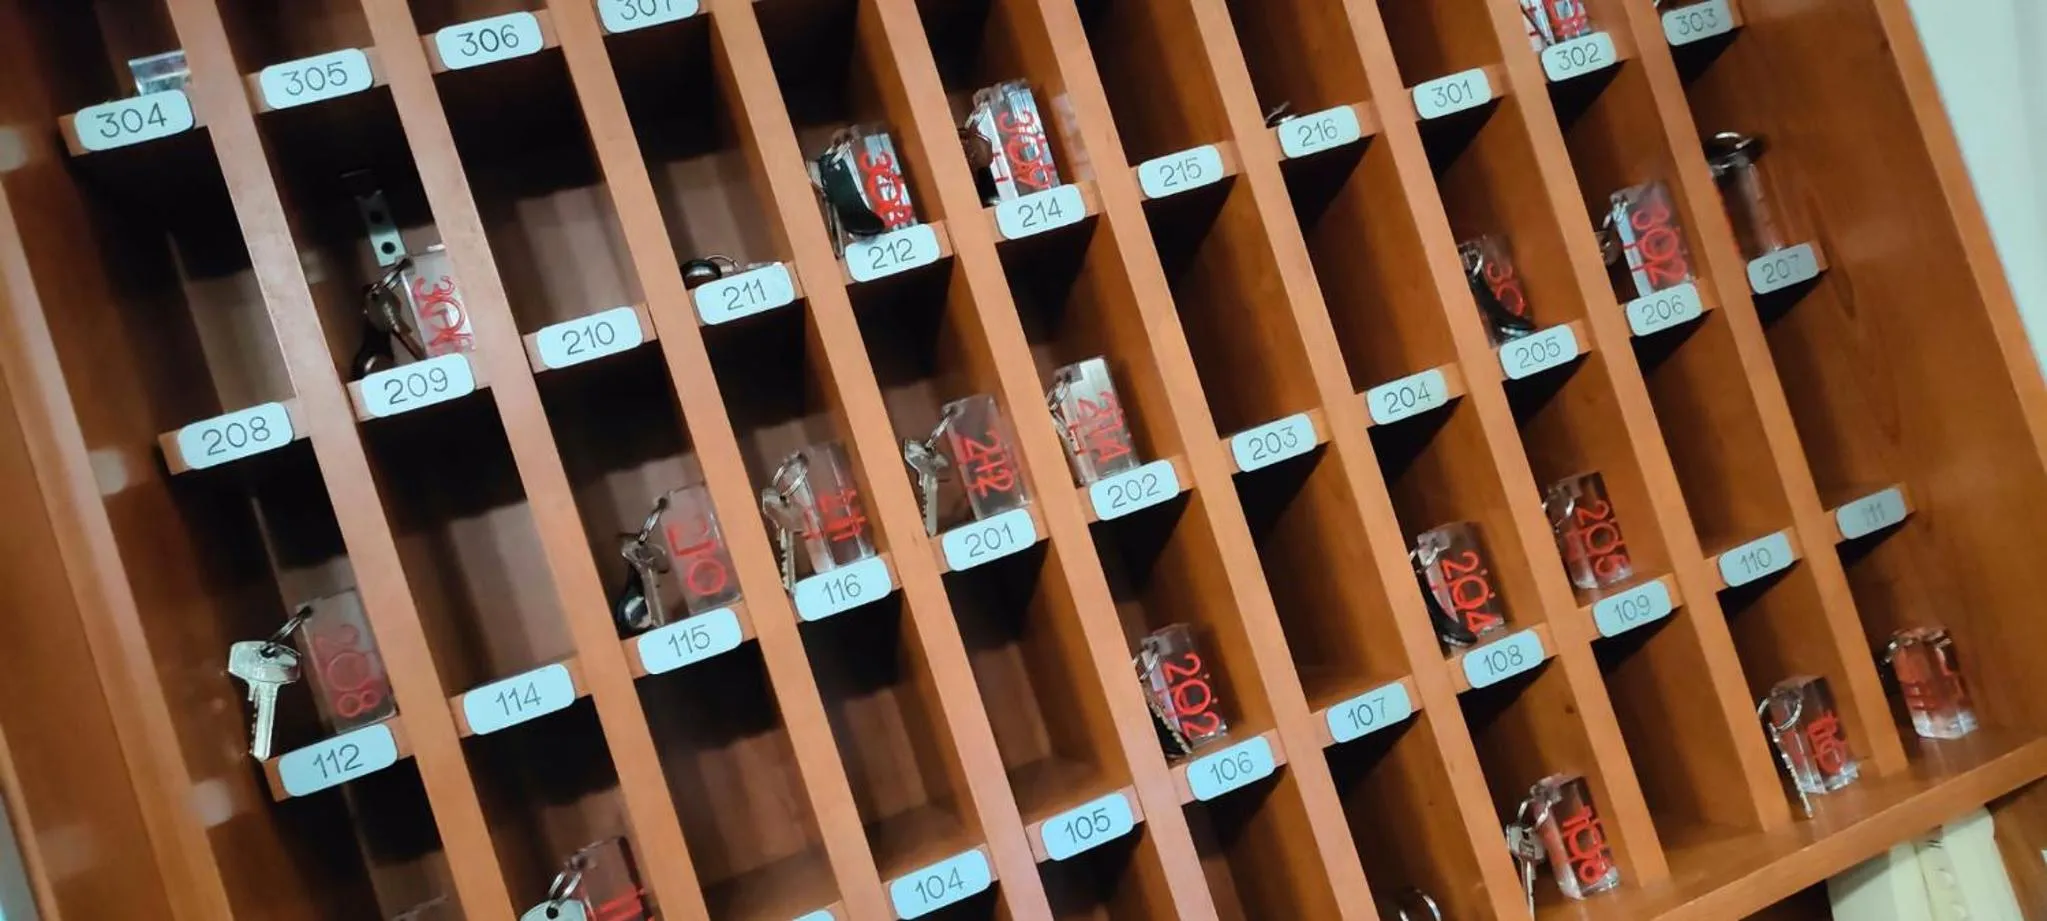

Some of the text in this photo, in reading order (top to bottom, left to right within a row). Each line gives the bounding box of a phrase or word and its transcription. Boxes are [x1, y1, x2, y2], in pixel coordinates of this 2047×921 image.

[1676, 8, 1717, 35] 303
[458, 24, 519, 56] 306
[1556, 42, 1602, 71] 302
[282, 61, 347, 96] 305
[1432, 80, 1472, 108] 301
[96, 102, 168, 139] 304
[1298, 119, 1337, 147] 216
[1160, 157, 1201, 187] 215
[1017, 196, 1063, 229] 214
[868, 238, 916, 270] 212
[1631, 203, 1687, 286] 302
[723, 278, 766, 311] 211
[1486, 262, 1525, 317] 30
[1642, 295, 1685, 326] 206
[562, 322, 614, 355] 210
[1510, 336, 1560, 369] 205
[384, 368, 448, 405] 209
[1384, 382, 1430, 414] 204
[202, 415, 271, 456] 208
[1249, 426, 1297, 461] 203
[1108, 473, 1160, 509] 202
[965, 523, 1014, 558] 201
[1575, 500, 1628, 577] 205
[1741, 547, 1771, 574] 110
[822, 573, 862, 604] 116
[1442, 551, 1501, 638] 204
[1614, 595, 1651, 625] 109
[668, 624, 710, 657] 115
[313, 624, 381, 718] 208
[1484, 645, 1523, 675] 108
[496, 682, 541, 716] 114
[1162, 652, 1221, 741] 202
[1348, 696, 1390, 730] 107
[313, 744, 363, 778] 112
[1210, 751, 1253, 784] 106
[1065, 808, 1110, 843] 105
[1563, 806, 1611, 886] 108
[915, 867, 964, 903] 104
